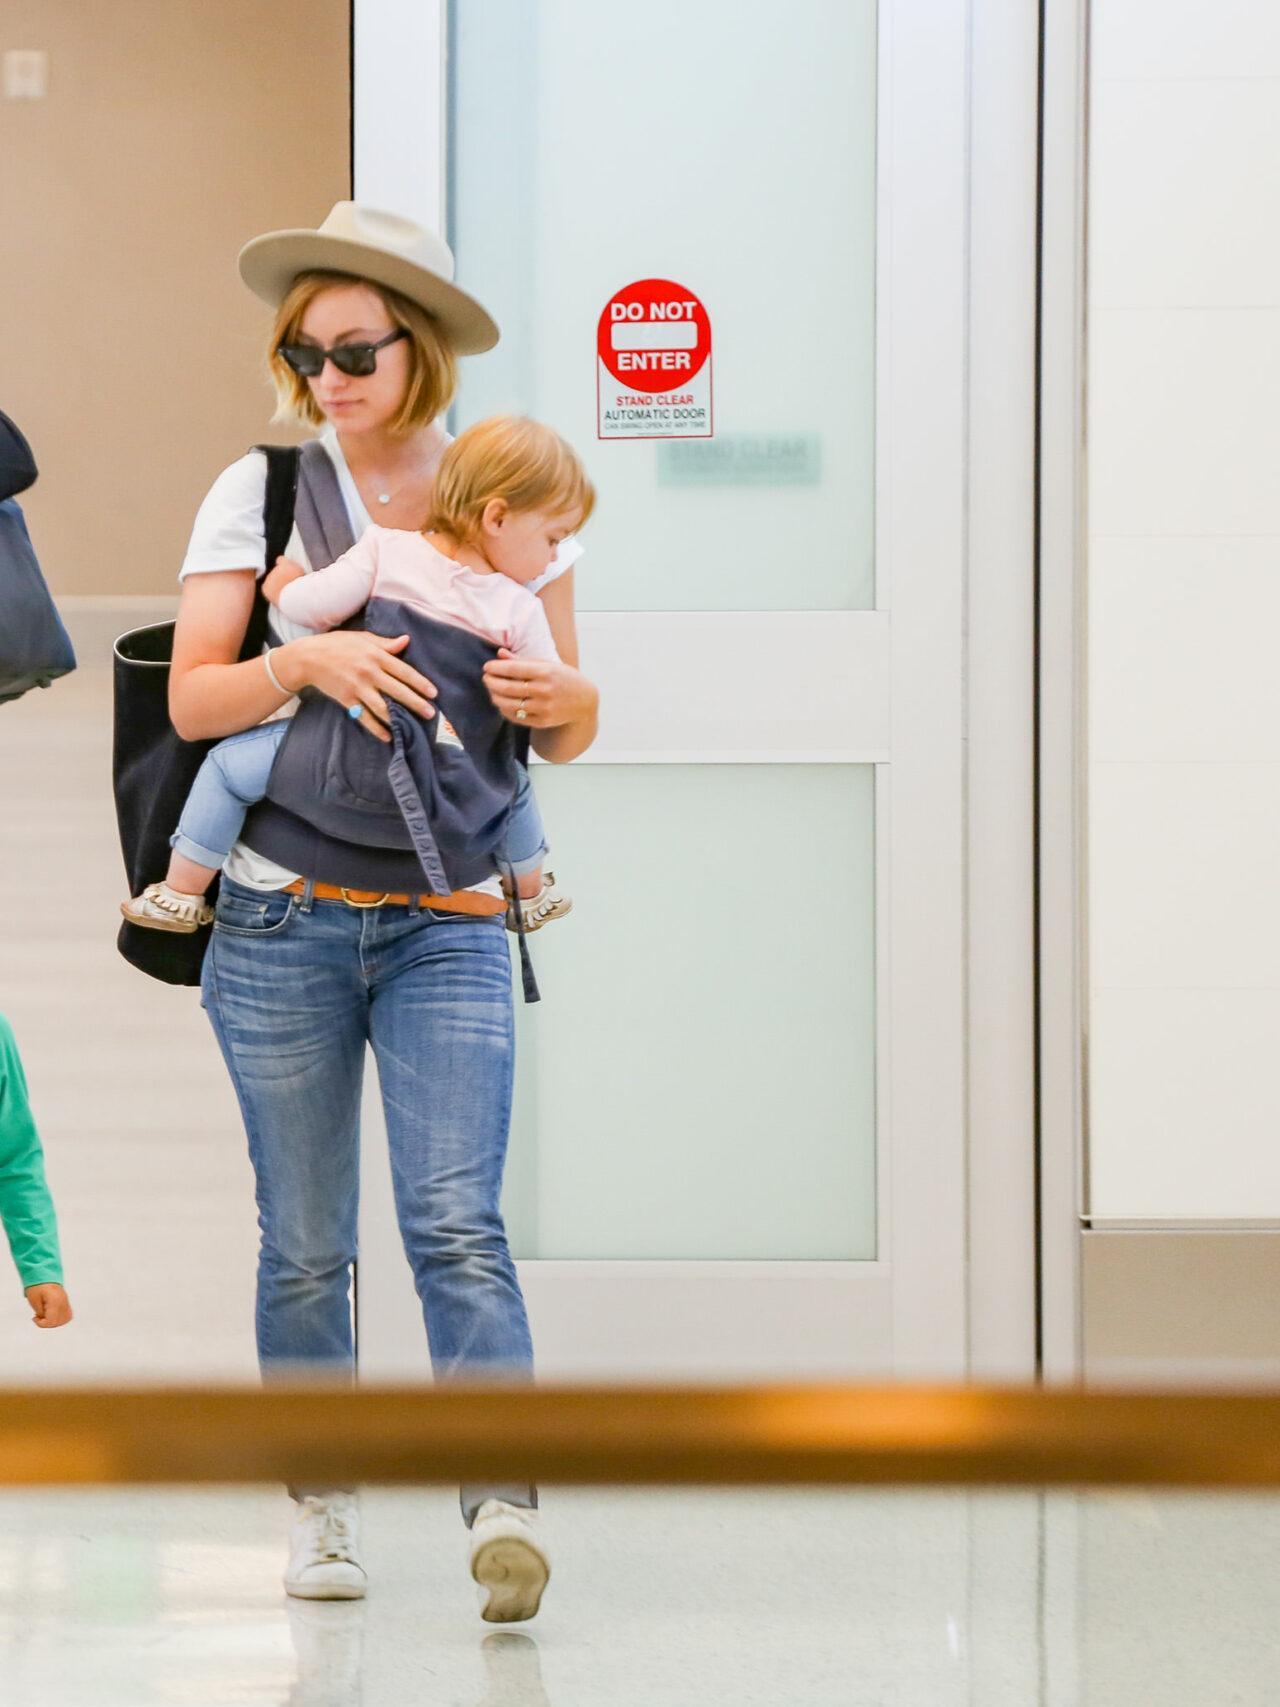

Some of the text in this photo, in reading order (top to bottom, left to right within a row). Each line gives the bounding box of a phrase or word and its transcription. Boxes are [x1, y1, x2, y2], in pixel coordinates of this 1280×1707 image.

[611, 301, 698, 321] DO NOT
[617, 352, 691, 371] ENTER
[616, 395, 694, 406] STAND CLEAR
[605, 408, 706, 420] AUTOMATIC DOOR
